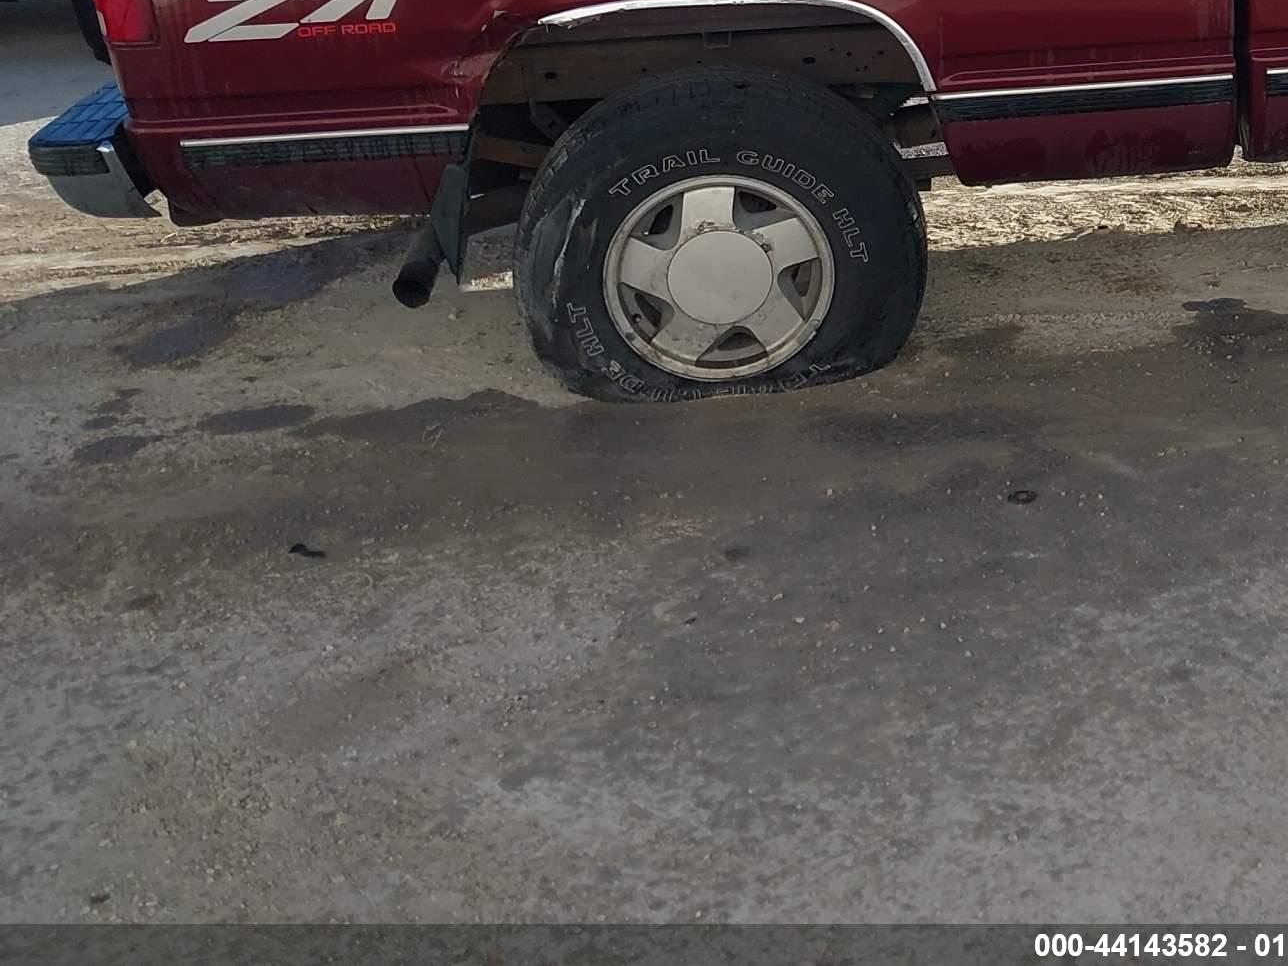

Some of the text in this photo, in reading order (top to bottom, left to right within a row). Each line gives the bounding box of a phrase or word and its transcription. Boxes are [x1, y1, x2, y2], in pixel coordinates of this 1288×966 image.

[298, 21, 396, 38] OFF ROAD
[608, 149, 869, 263] TRAIL GUIDE HLT
